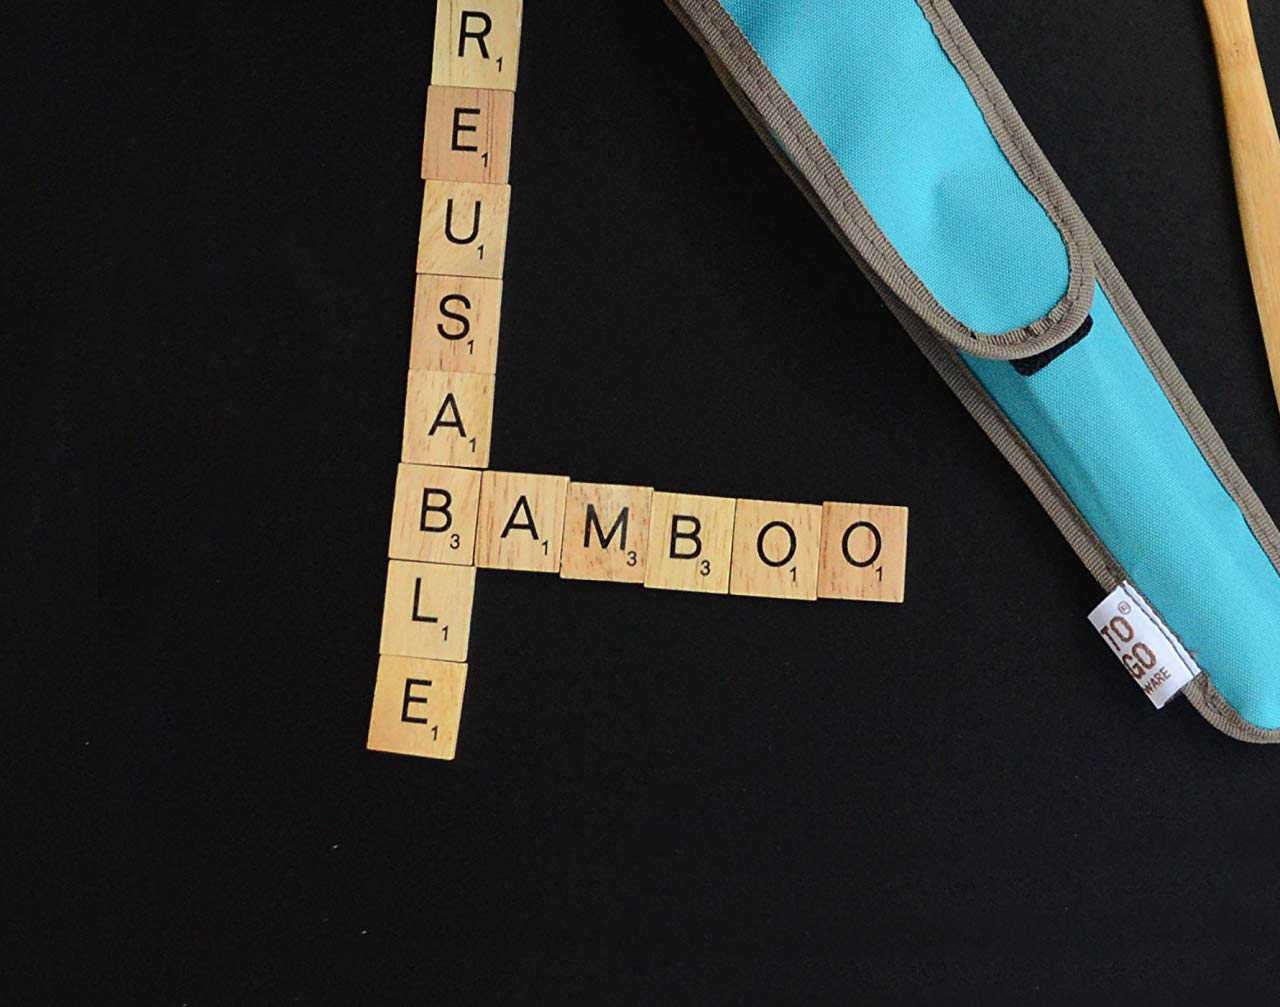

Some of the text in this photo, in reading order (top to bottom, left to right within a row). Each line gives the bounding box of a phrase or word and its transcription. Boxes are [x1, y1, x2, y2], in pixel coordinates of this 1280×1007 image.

[400, 10, 492, 725] REUSABLE
[419, 487, 883, 569] BAMBOO
[1100, 615, 1135, 652] TO
[1121, 642, 1157, 680] GO
[1143, 666, 1171, 695] WARE
